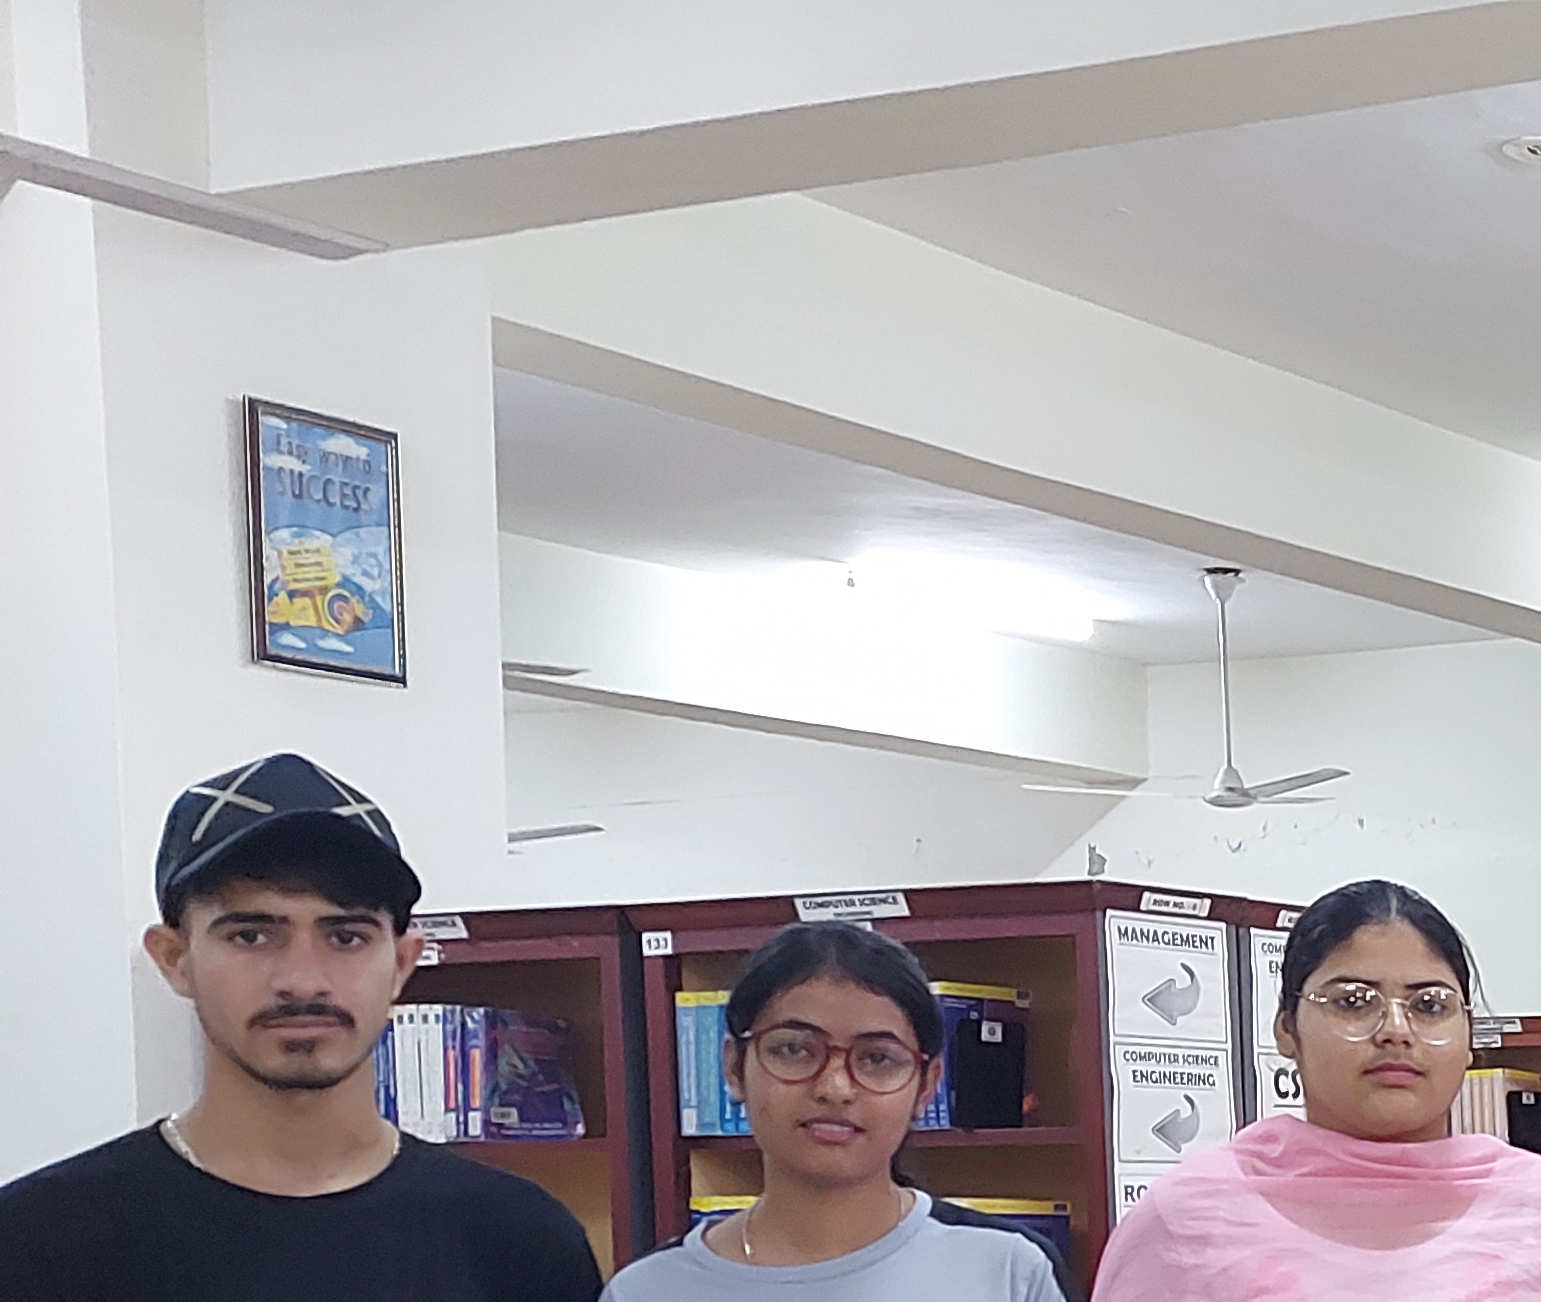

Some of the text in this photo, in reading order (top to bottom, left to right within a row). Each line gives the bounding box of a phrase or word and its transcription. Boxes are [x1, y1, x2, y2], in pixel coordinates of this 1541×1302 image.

[276, 467, 373, 514] SUCCESS
[1117, 925, 1216, 951] MANAGEMENT
[1123, 1050, 1220, 1067] COMPUTER SCIENCE
[1132, 1069, 1216, 1087] ENGINEERING
[1274, 1067, 1301, 1101] CS
